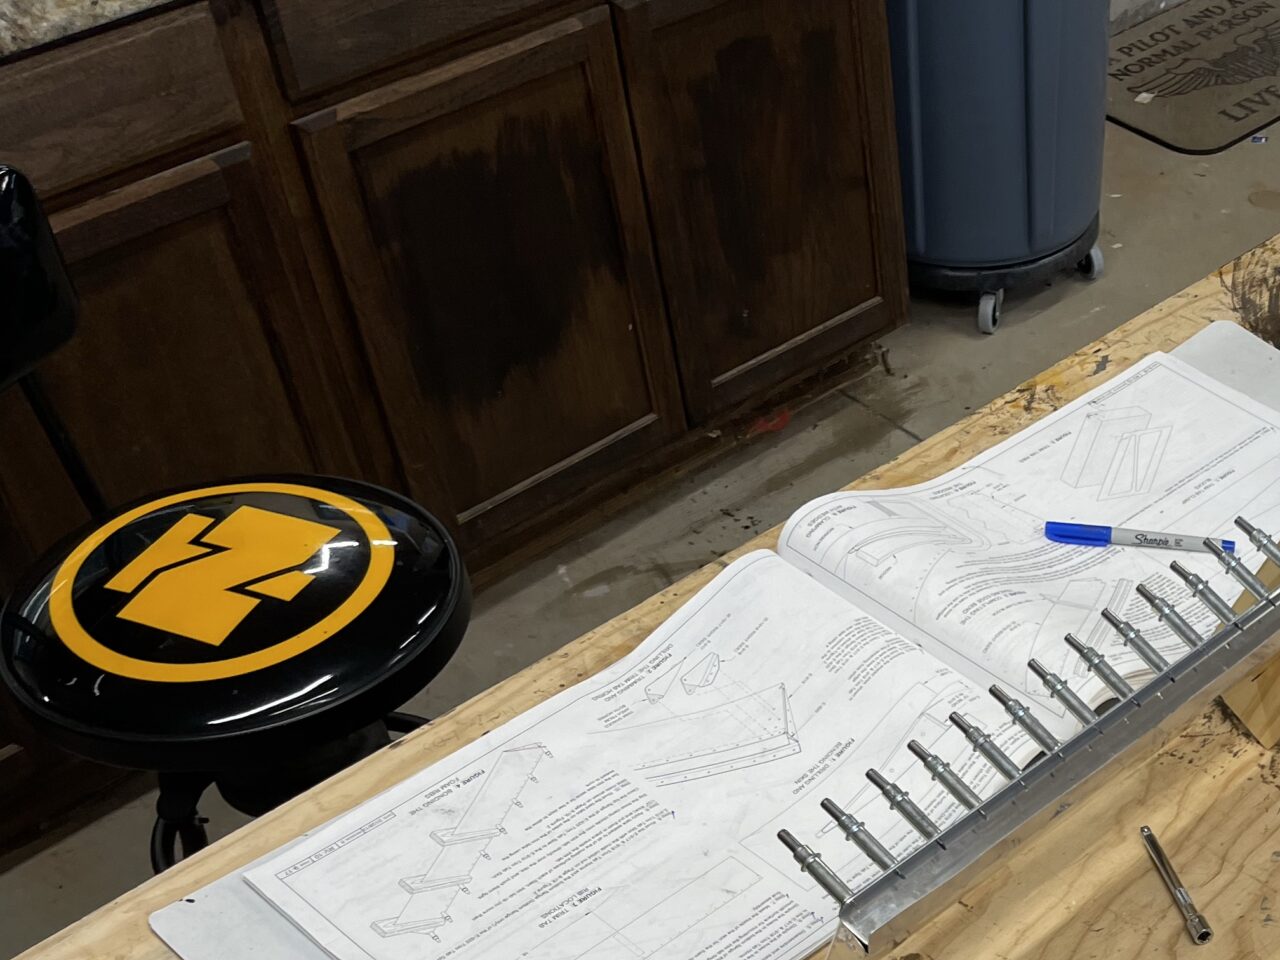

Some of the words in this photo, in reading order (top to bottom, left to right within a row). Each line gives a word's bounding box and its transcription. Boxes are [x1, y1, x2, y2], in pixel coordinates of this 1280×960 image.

[1108, 40, 1201, 81] NORMAL
[1195, 1, 1276, 41] PERSON
[1118, 24, 1182, 57] PILOT
[1182, 5, 1226, 28] AND
[1135, 533, 1169, 546] Sharpie
